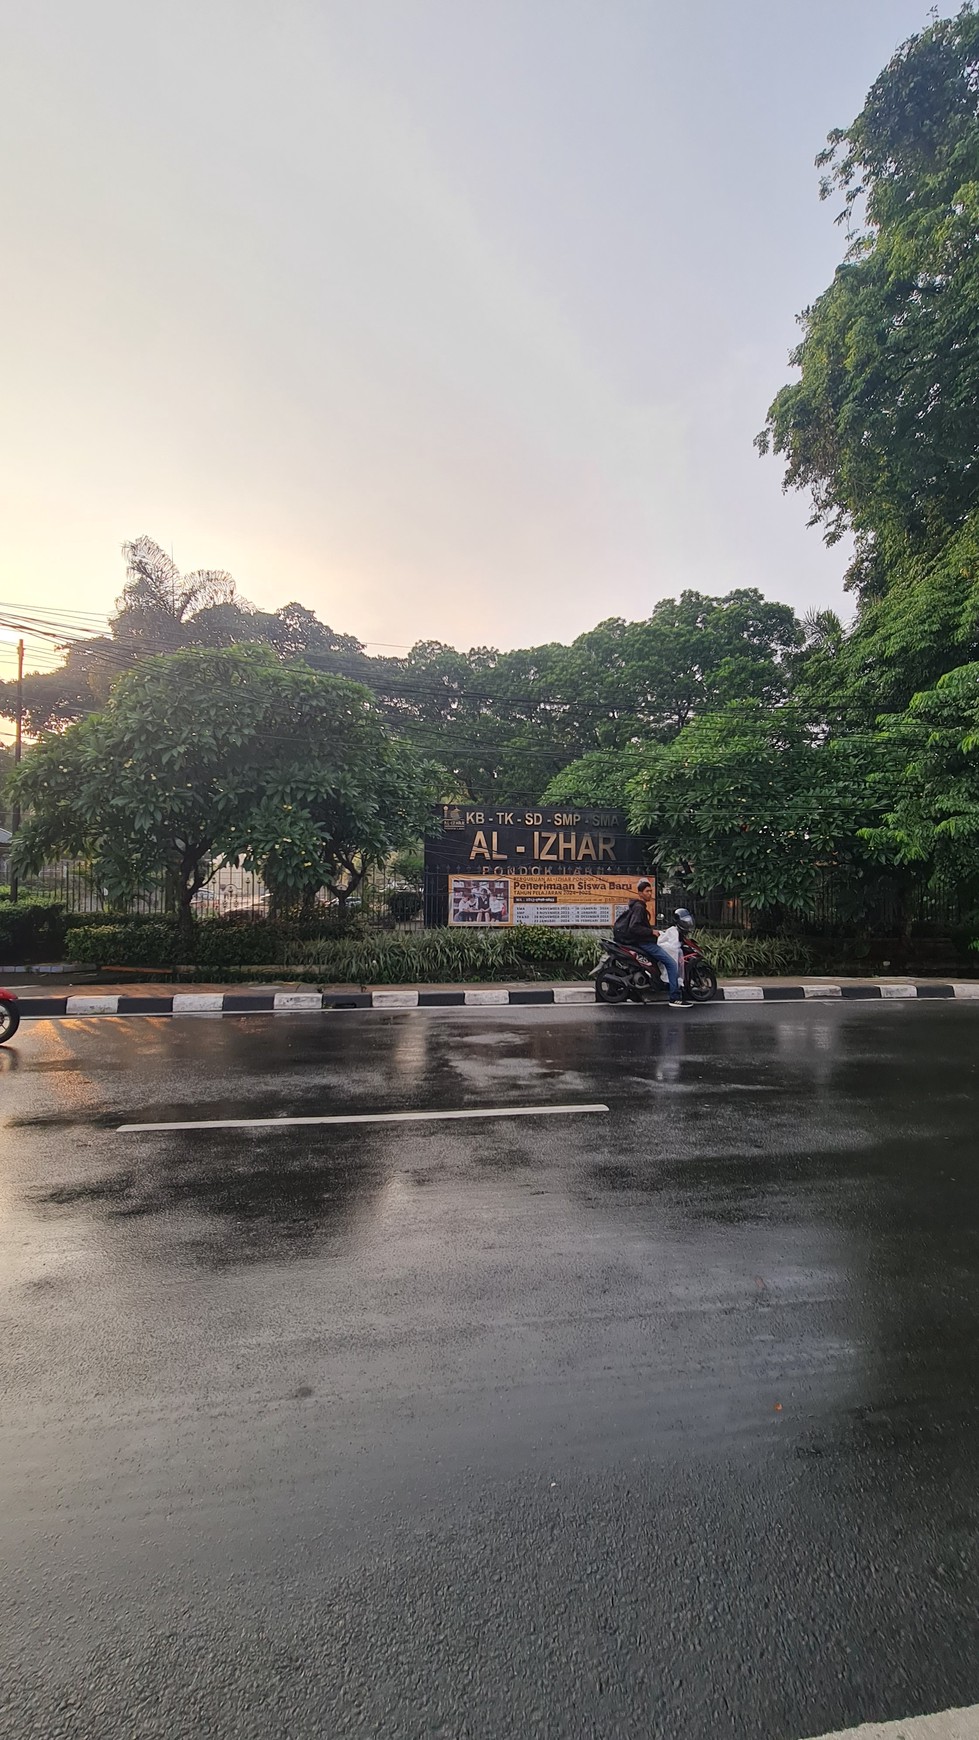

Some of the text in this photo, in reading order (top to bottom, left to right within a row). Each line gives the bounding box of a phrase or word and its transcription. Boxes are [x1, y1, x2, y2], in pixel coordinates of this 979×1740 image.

[466, 812, 484, 824] KB
[496, 812, 514, 825] TK
[525, 812, 542, 826] SD
[554, 813, 580, 826] SMP
[592, 814, 619, 826] SMA
[469, 830, 508, 860] AL
[534, 831, 617, 861] IZHAR
[482, 866, 552, 875] PONDOK
[514, 882, 632, 890] Penerimaan Siswa Baru
